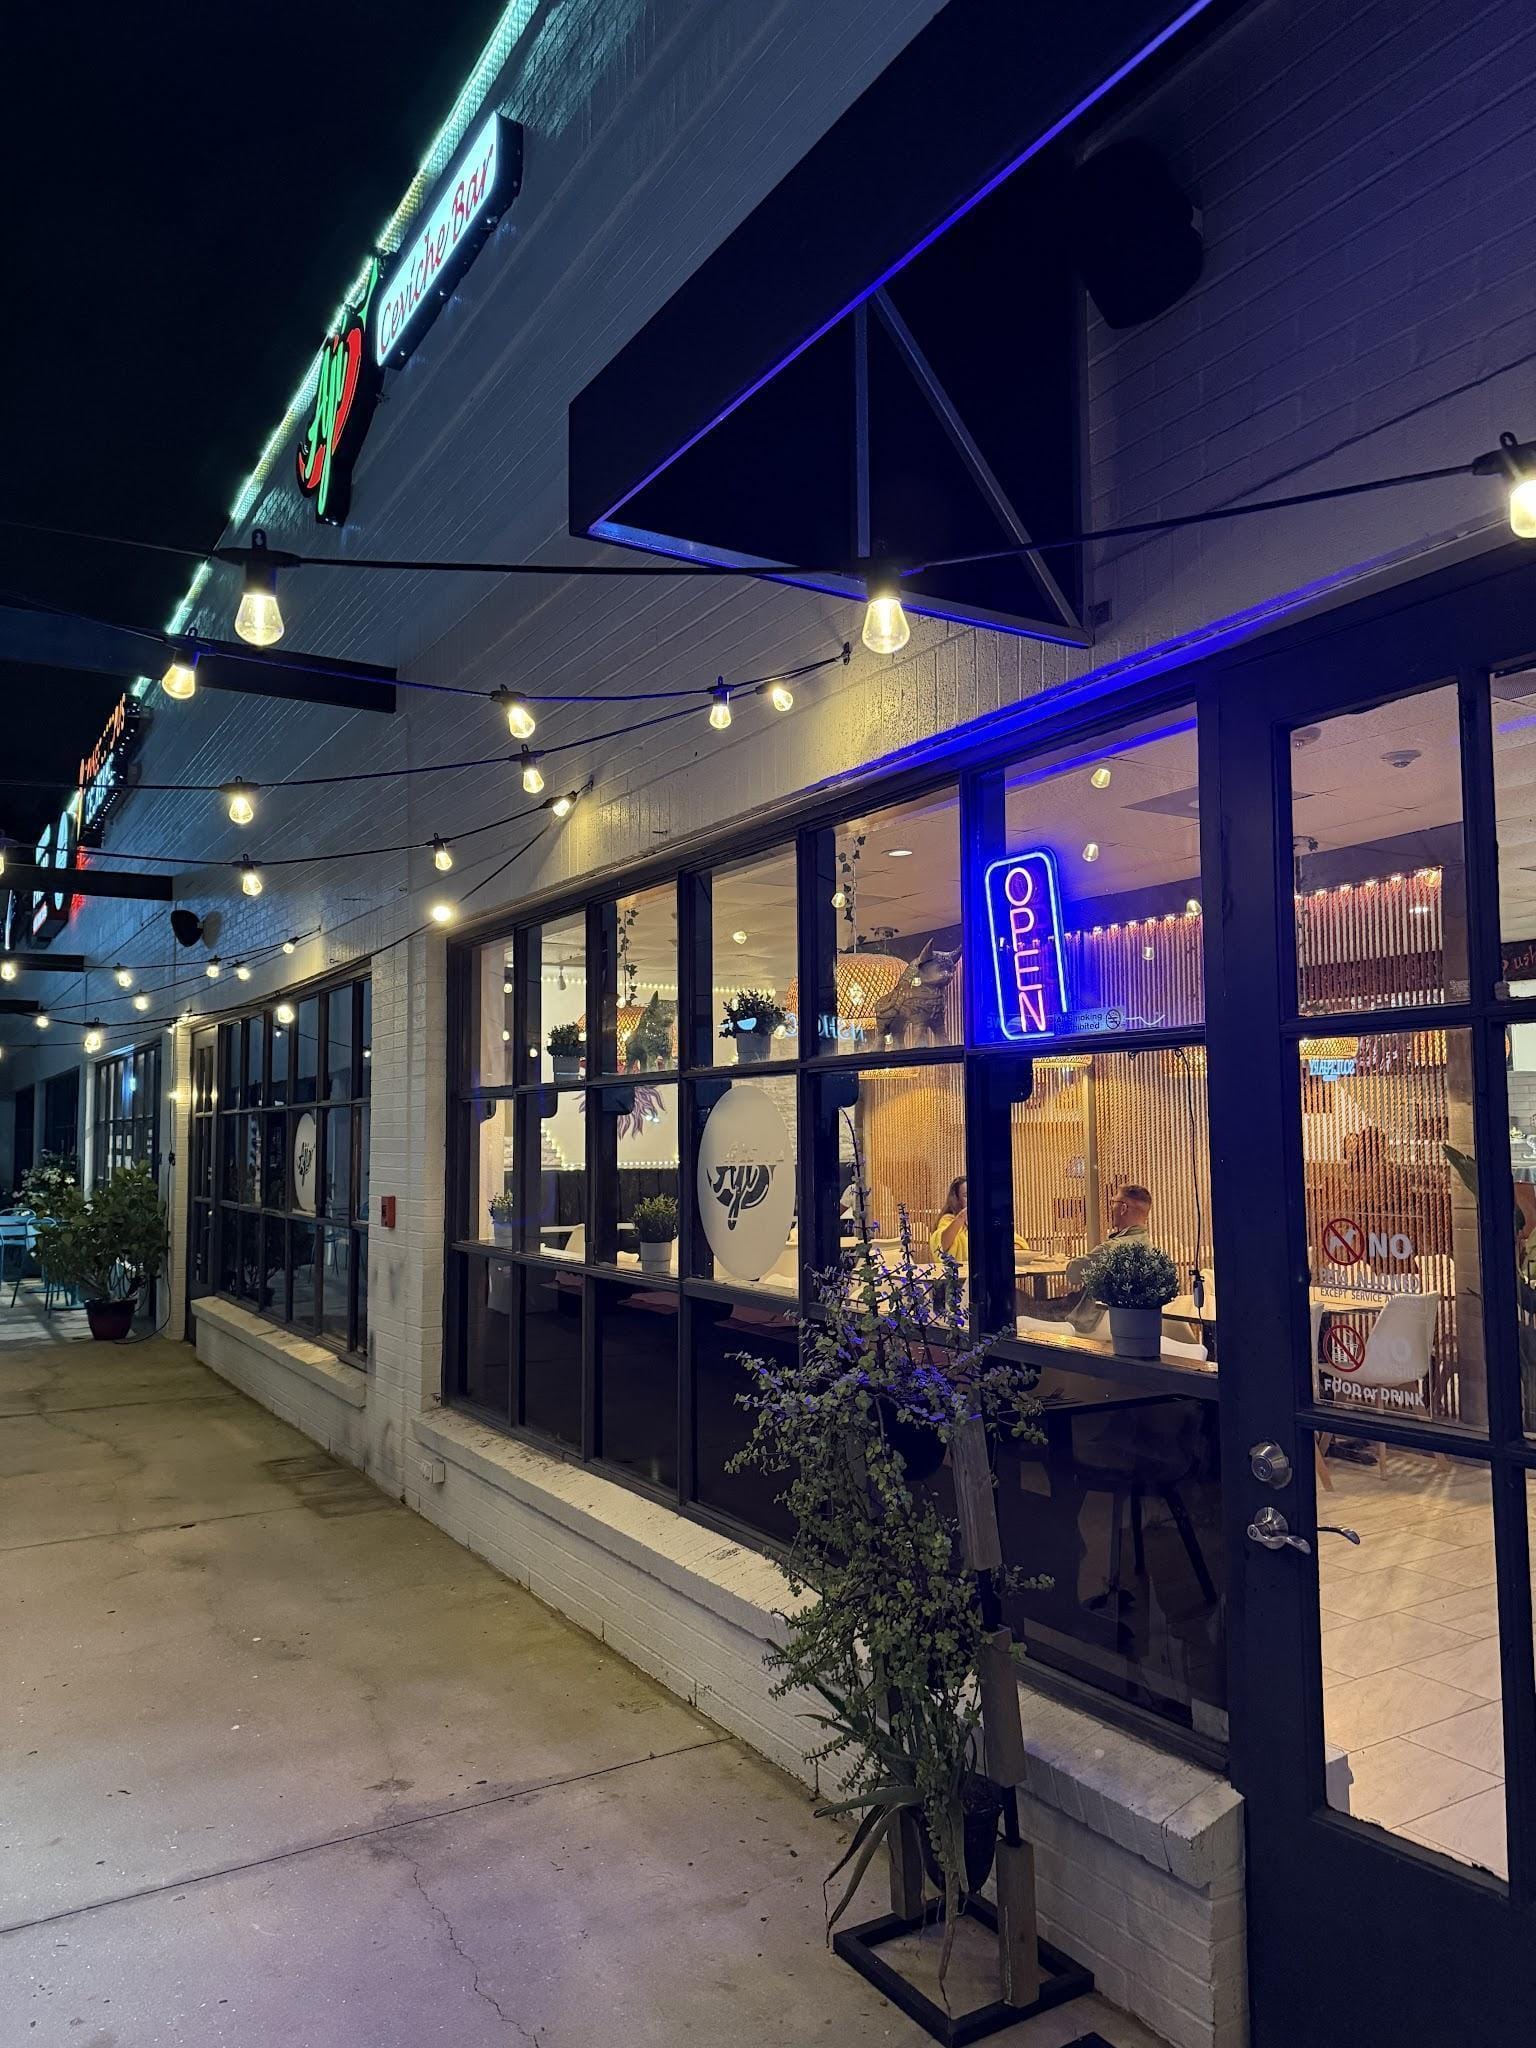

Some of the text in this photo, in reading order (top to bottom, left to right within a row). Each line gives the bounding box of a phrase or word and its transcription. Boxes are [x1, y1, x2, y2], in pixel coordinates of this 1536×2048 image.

[380, 143, 494, 355] Ceviche Bar
[1004, 866, 1047, 1033] OPEN
[1368, 1232, 1413, 1260] NO
[1321, 1288, 1347, 1300] EXCEPT
[1351, 1291, 1383, 1303] SERVICE
[1324, 1378, 1425, 1407] FOOD or DRINK
